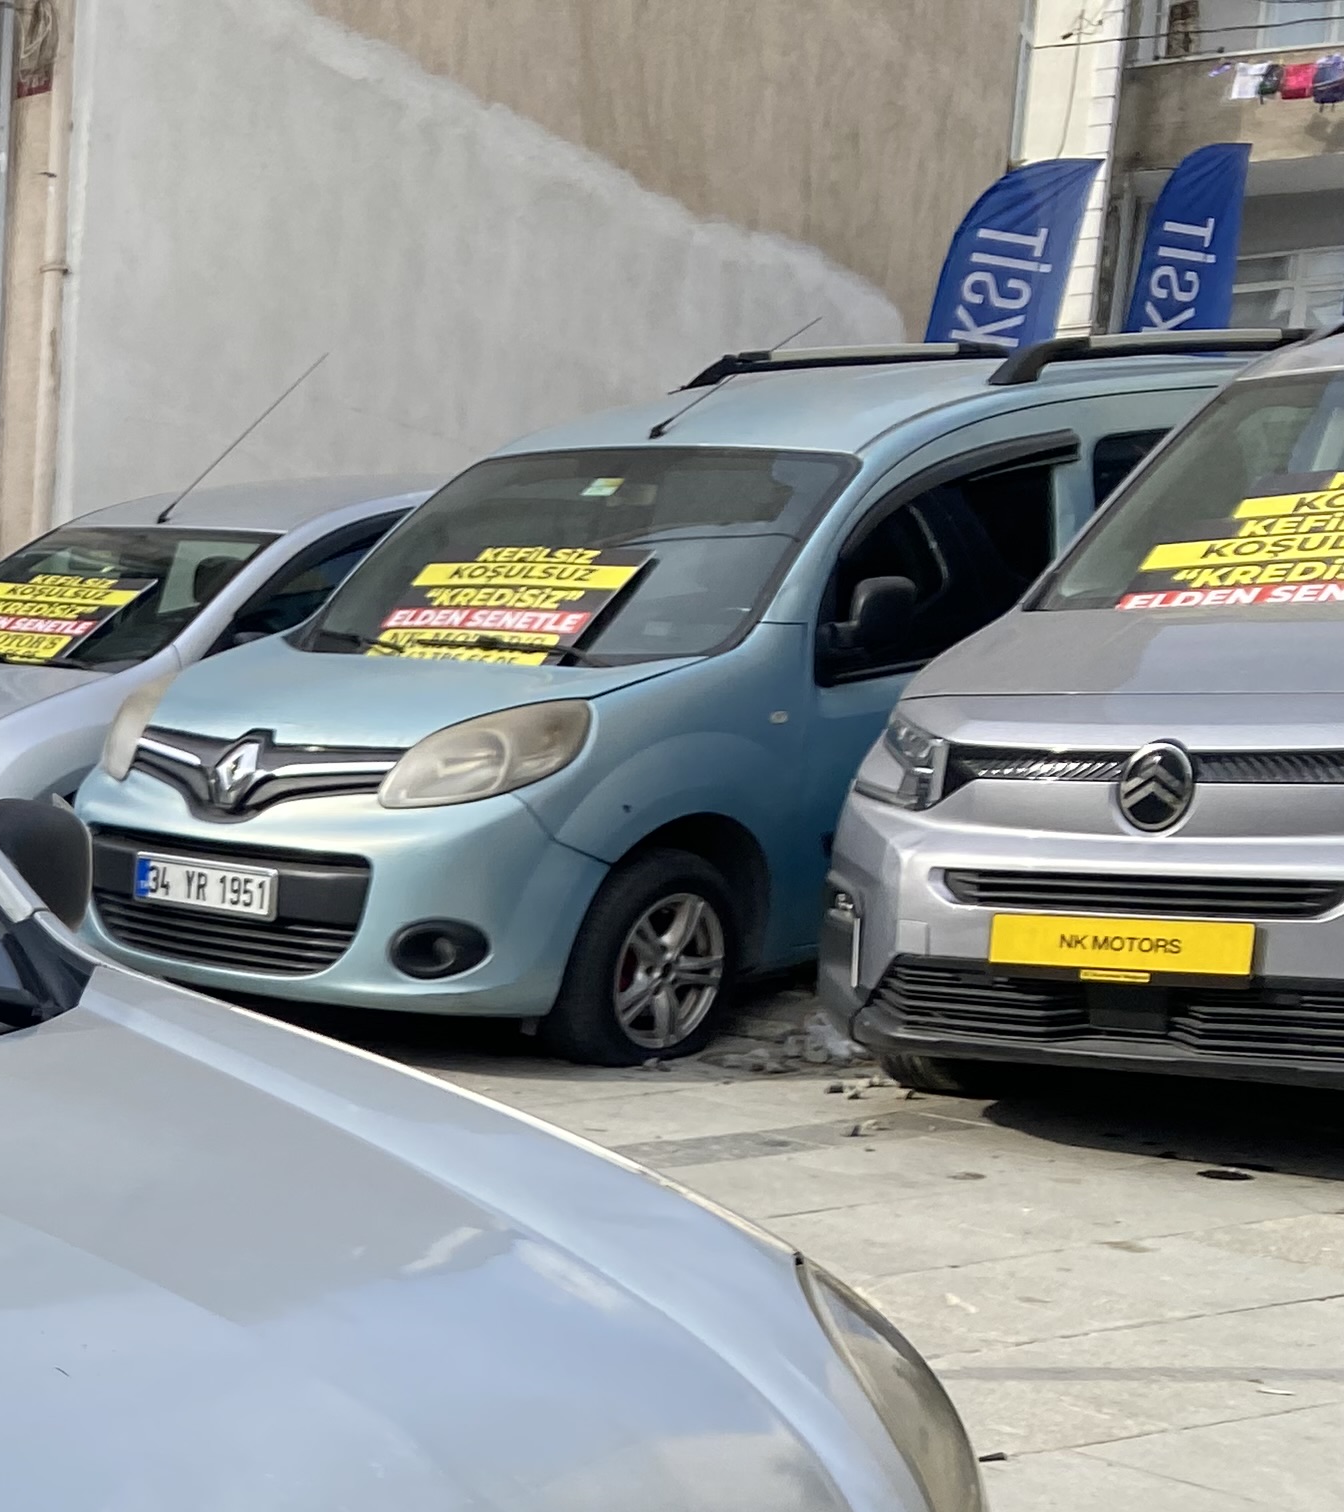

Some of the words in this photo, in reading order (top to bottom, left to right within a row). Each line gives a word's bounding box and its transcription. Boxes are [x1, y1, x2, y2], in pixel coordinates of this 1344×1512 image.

[1291, 492, 1344, 513] KO
[1238, 512, 1344, 537] KEFİ
[476, 546, 602, 564] KEFİLSİZ
[1200, 534, 1344, 559] KOŞUL
[28, 574, 119, 590] KEFİLSİZ
[448, 564, 600, 582] KOŞULSUZ
[1172, 558, 1344, 589] “KREDİ
[7, 584, 111, 601] KOŞULSUZ
[1123, 587, 1262, 609] ELDEN
[1265, 583, 1344, 603] SEN
[12, 617, 94, 636] SENETLE
[387, 609, 469, 628] ELDEN
[468, 610, 581, 633] SENETLE
[149, 865, 170, 896] 34
[185, 869, 208, 901] YR
[219, 875, 266, 910] 1951
[1059, 933, 1089, 951] NK
[1091, 935, 1182, 954] MOTORS
